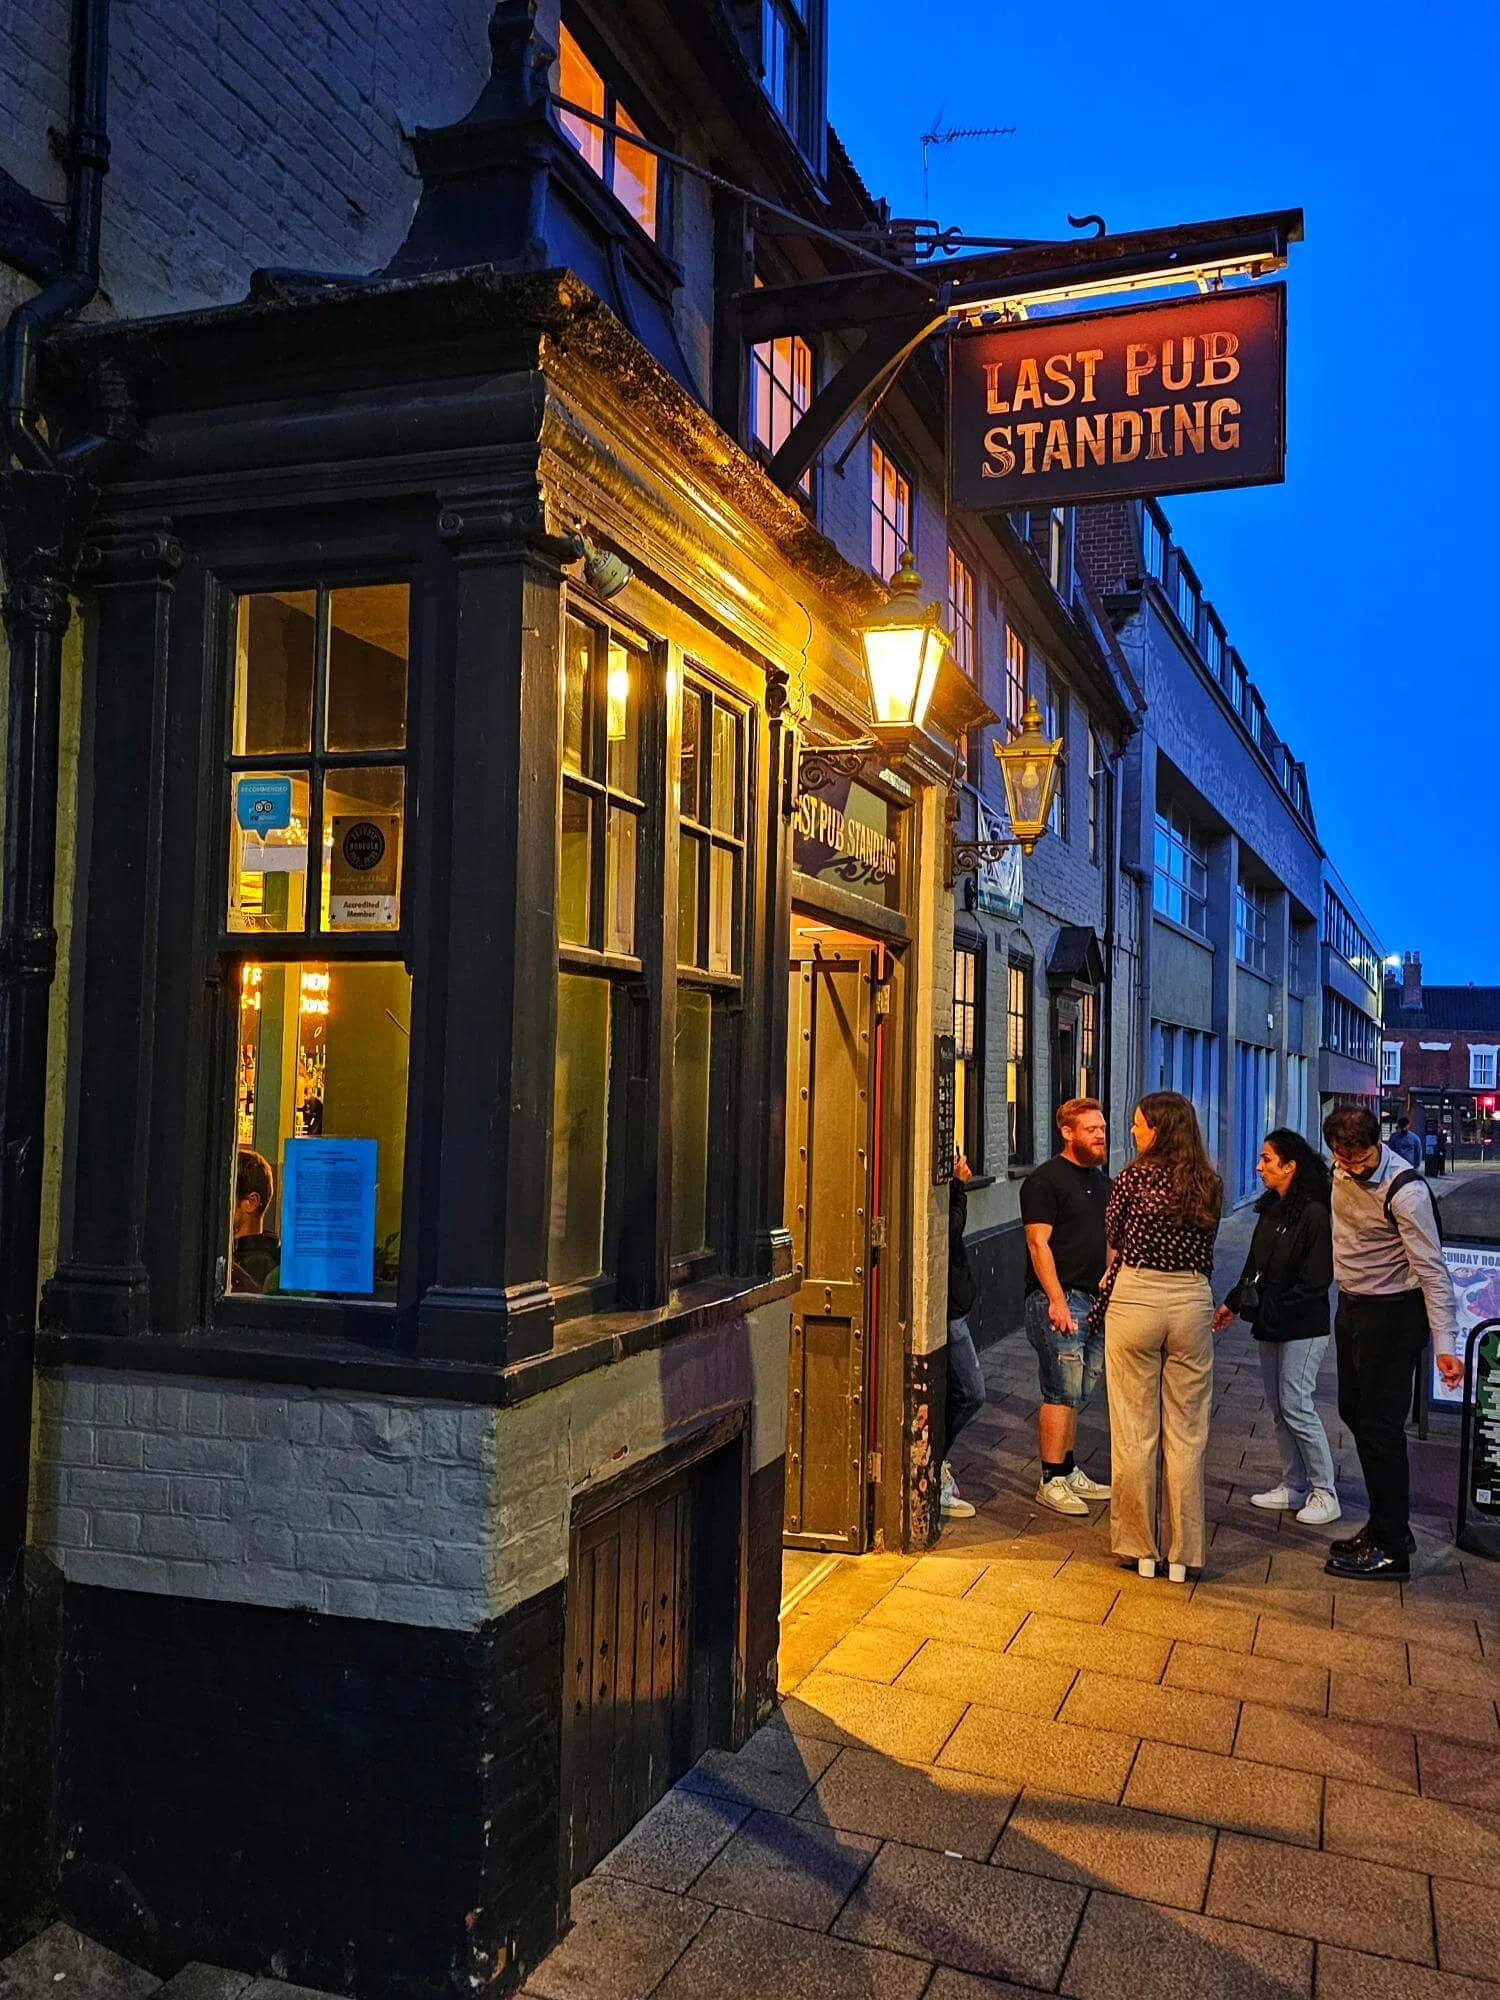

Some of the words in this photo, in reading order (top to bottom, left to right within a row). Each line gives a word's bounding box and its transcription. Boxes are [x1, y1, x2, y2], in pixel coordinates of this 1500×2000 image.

[982, 349, 1104, 415] LAST
[1126, 331, 1240, 397] PUB
[981, 398, 1241, 479] STANDING
[793, 793, 818, 840] AST
[819, 799, 845, 851] PUB
[847, 819, 896, 876] STANDING
[343, 901, 380, 909] Accredited
[346, 910, 377, 918] Member
